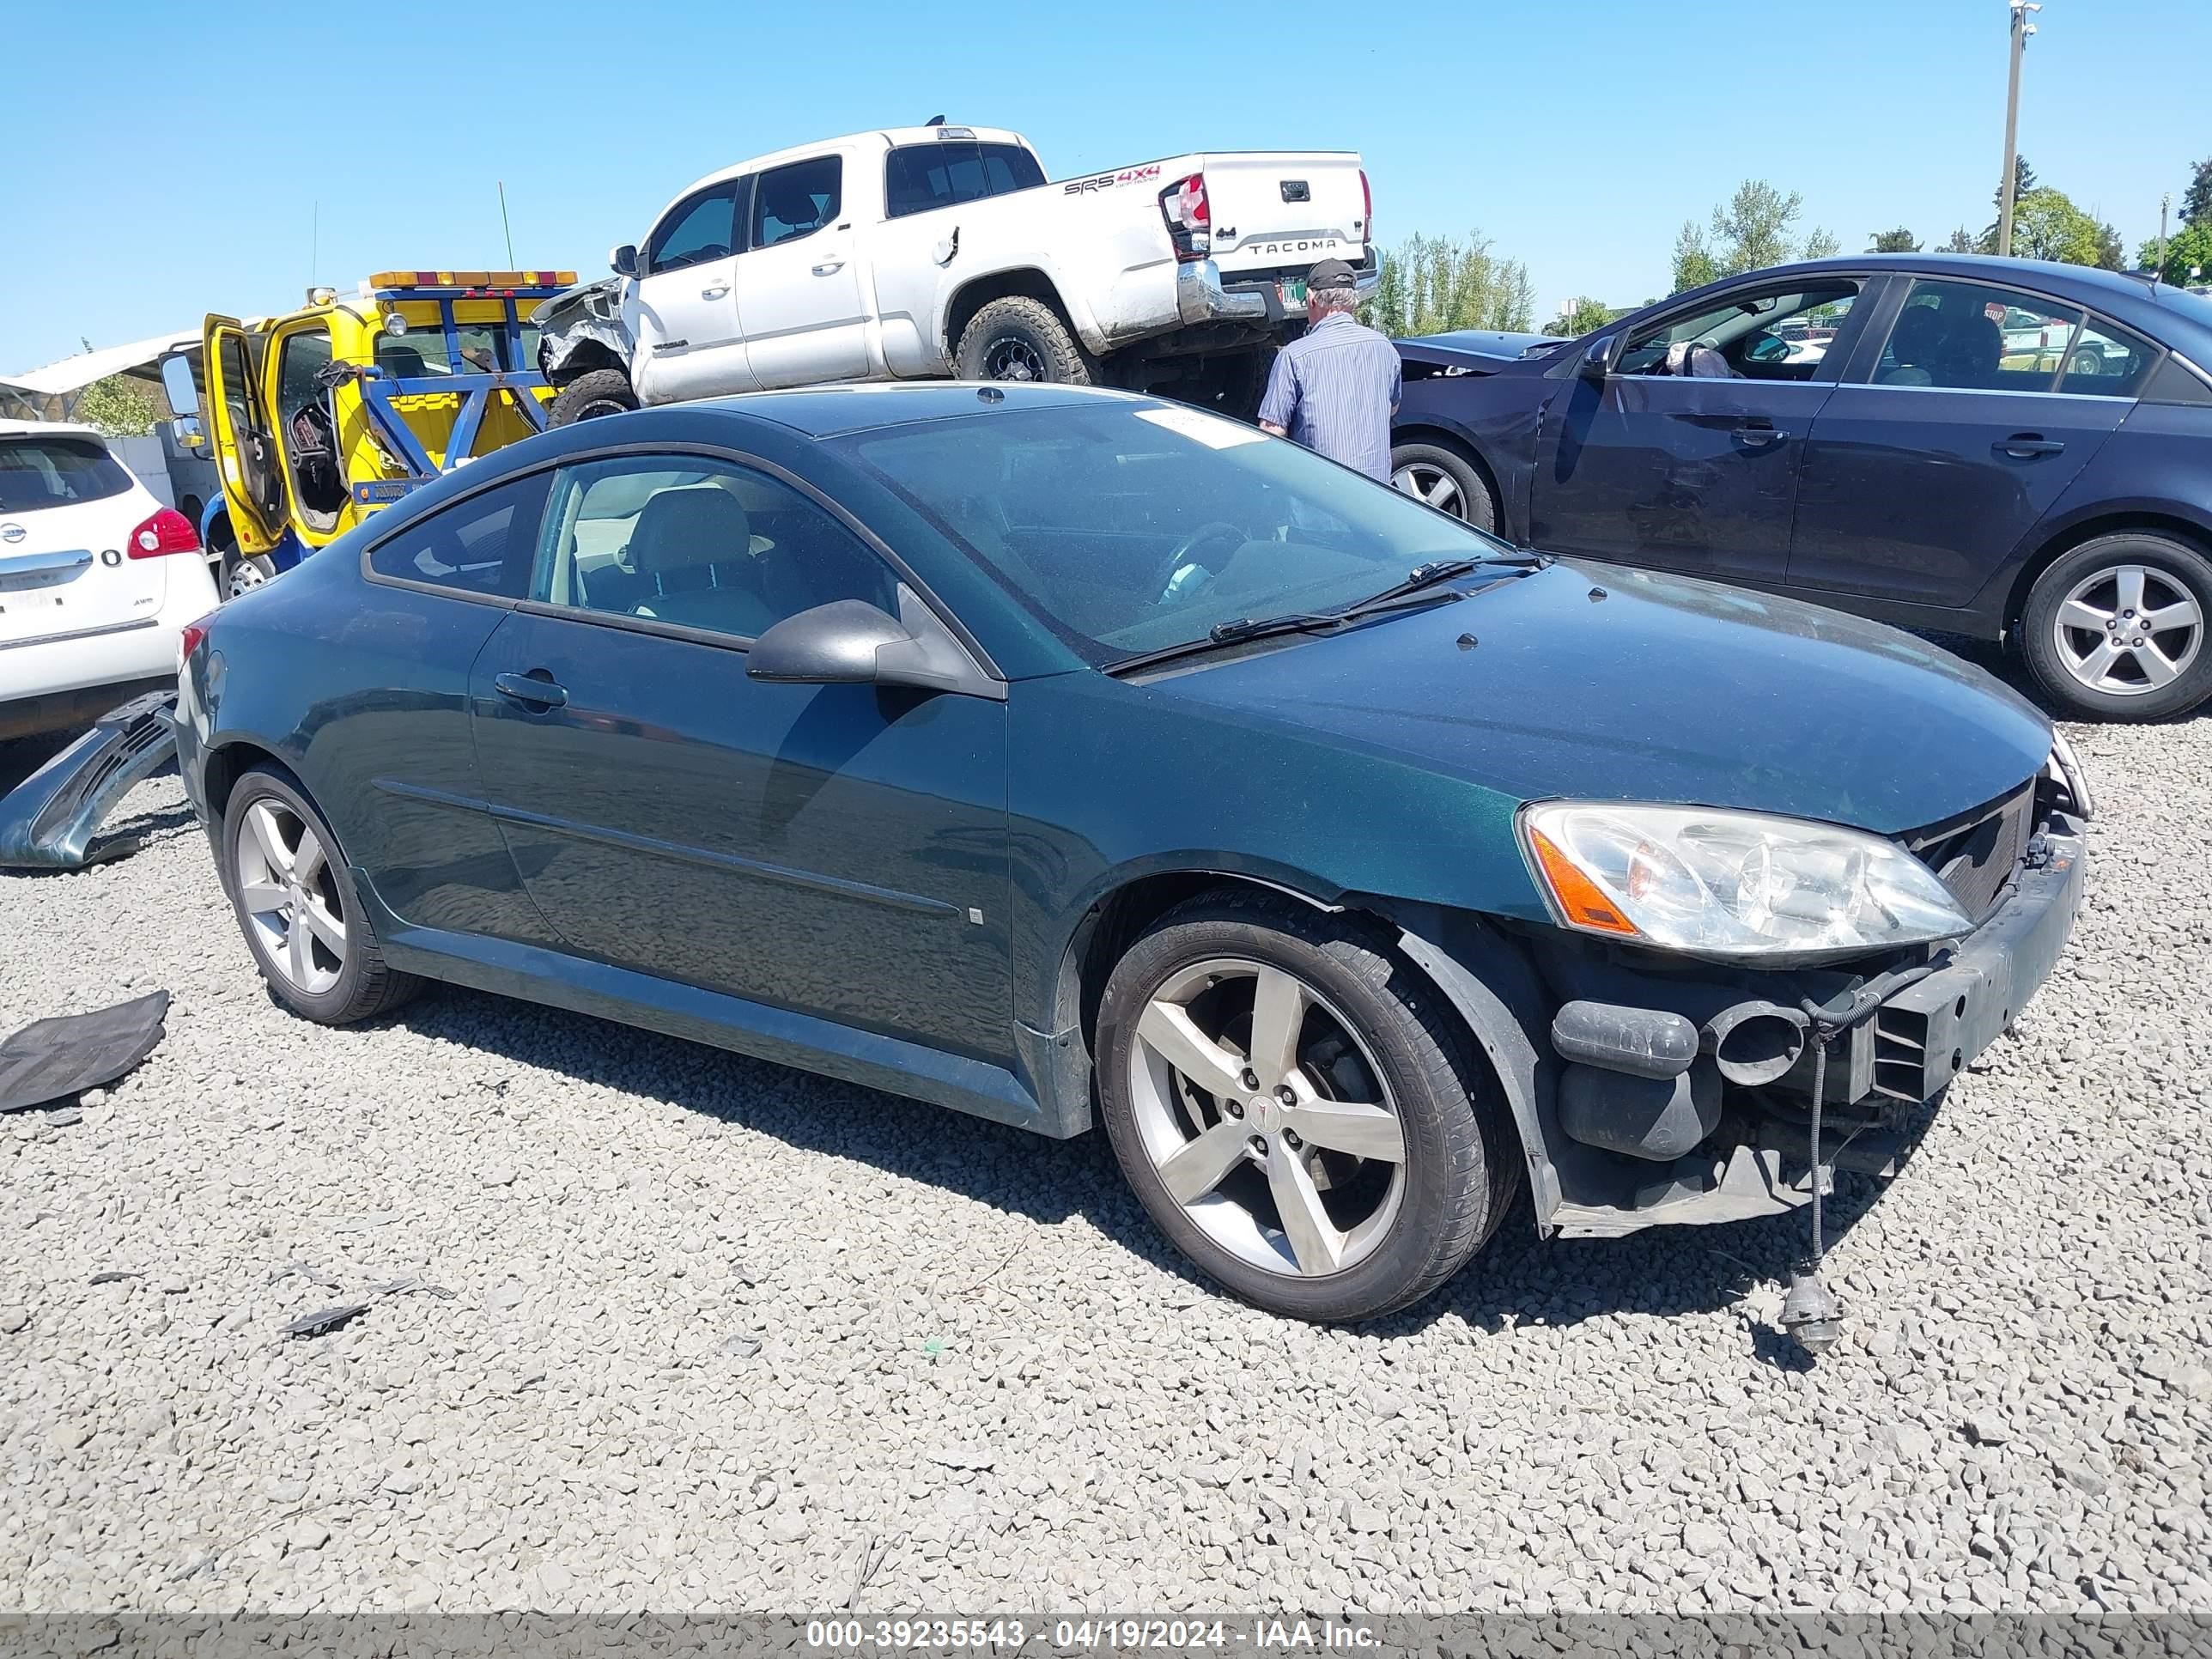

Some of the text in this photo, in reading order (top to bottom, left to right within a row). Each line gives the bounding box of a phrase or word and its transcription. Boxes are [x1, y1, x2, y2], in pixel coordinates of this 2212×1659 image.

[1064, 174, 1115, 195] SR5
[1249, 240, 1336, 255] TACOMA
[1984, 309, 2004, 320] STOP
